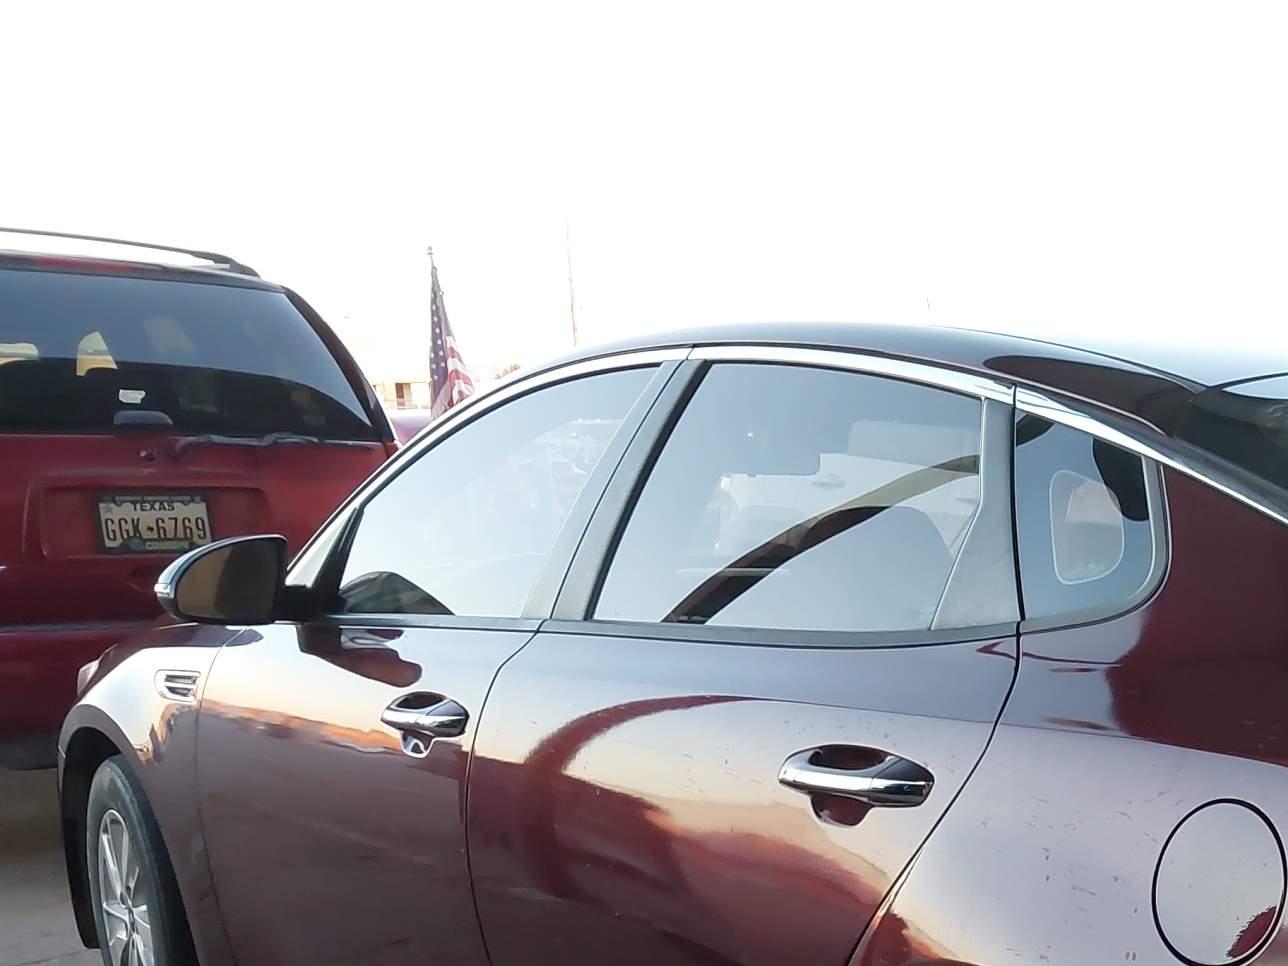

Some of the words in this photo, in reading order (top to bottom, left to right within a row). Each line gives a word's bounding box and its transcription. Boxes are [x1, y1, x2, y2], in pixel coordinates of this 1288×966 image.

[132, 501, 176, 512] TEXAS
[105, 517, 143, 542] GGK
[155, 516, 207, 541] 6769
